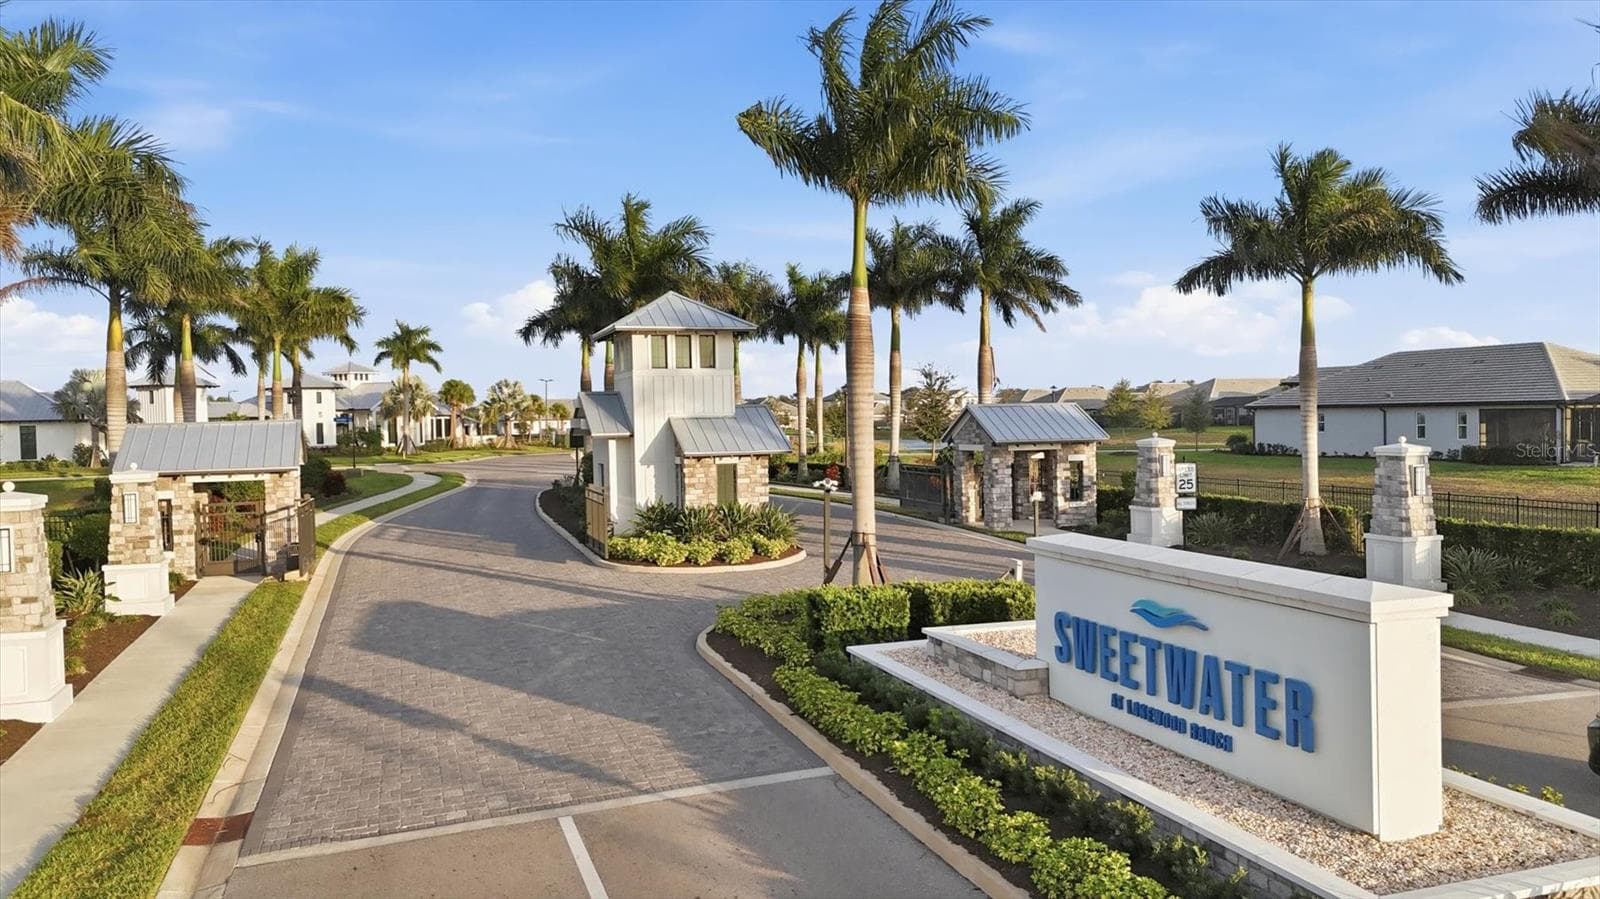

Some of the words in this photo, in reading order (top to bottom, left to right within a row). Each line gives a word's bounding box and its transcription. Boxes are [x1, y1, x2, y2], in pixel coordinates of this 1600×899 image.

[1179, 479, 1193, 490] 25
[1054, 611, 1315, 753] SWEETWATER
[1111, 693, 1124, 710] AT
[1126, 699, 1187, 734] LAKEWOOD
[1190, 723, 1233, 752] RANCH
